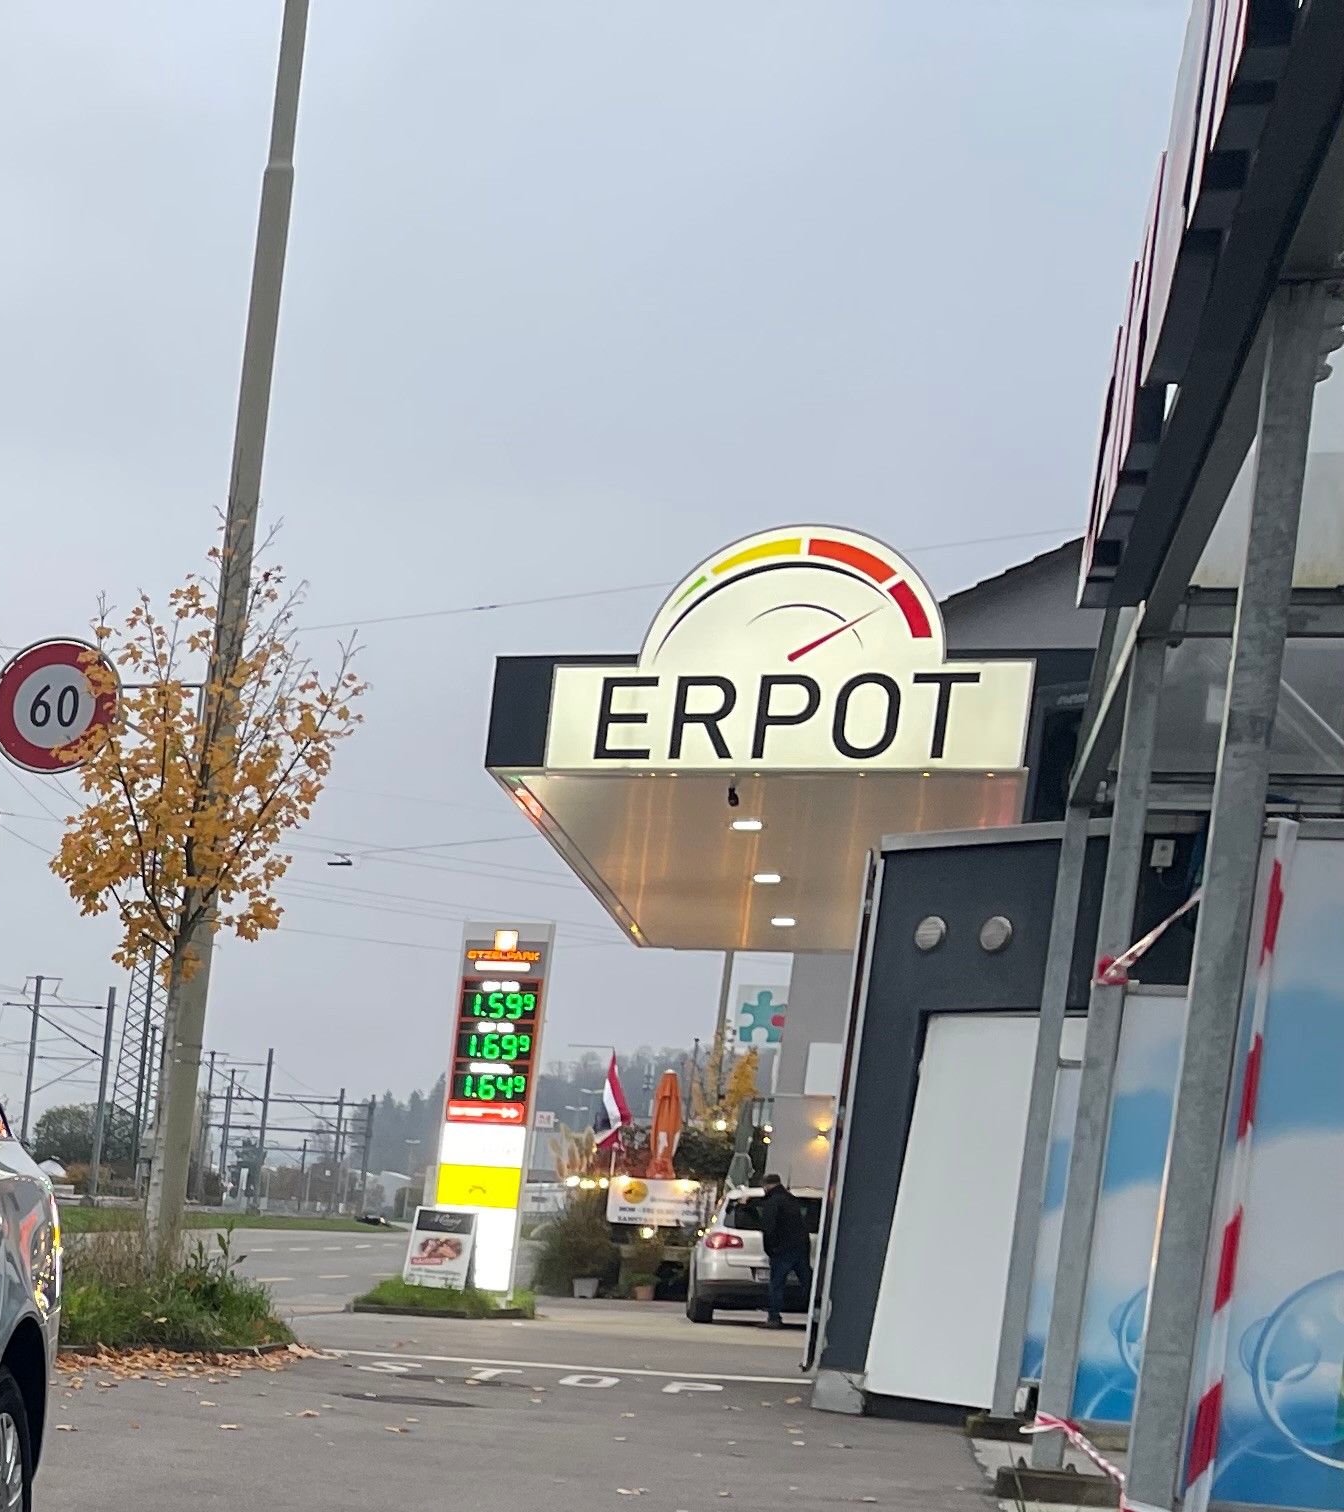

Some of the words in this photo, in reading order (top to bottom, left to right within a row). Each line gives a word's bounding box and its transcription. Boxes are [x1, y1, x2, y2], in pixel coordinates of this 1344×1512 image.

[29, 683, 80, 728] 60
[593, 671, 981, 760] ERPOT
[357, 1360, 725, 1393] STOP
